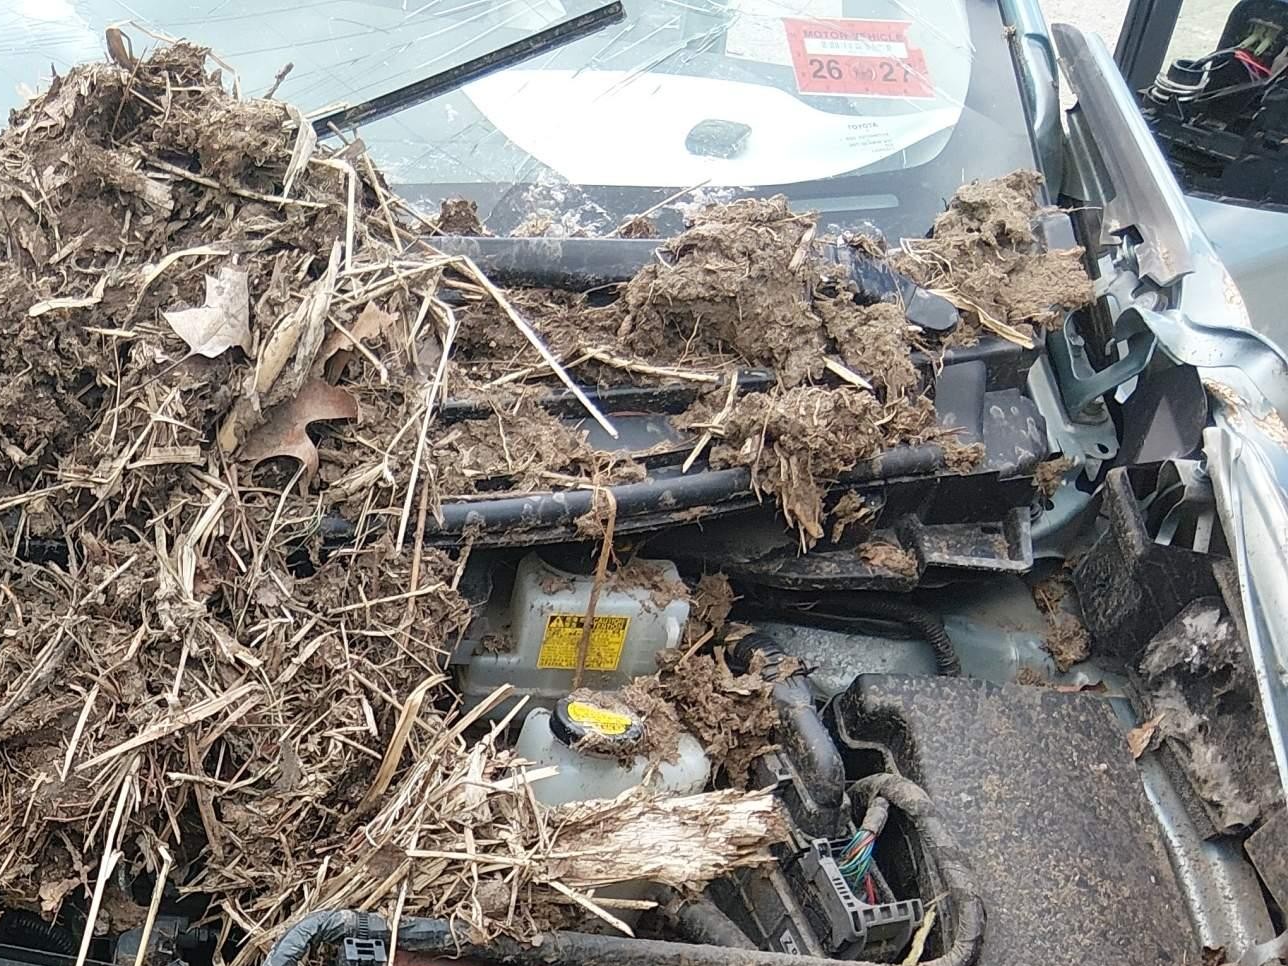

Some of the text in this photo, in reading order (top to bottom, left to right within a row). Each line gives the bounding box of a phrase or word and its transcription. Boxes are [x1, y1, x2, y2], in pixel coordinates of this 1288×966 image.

[803, 30, 848, 40] MOTOR
[809, 58, 913, 83] 26 27
[847, 121, 879, 130] TOYOTA
